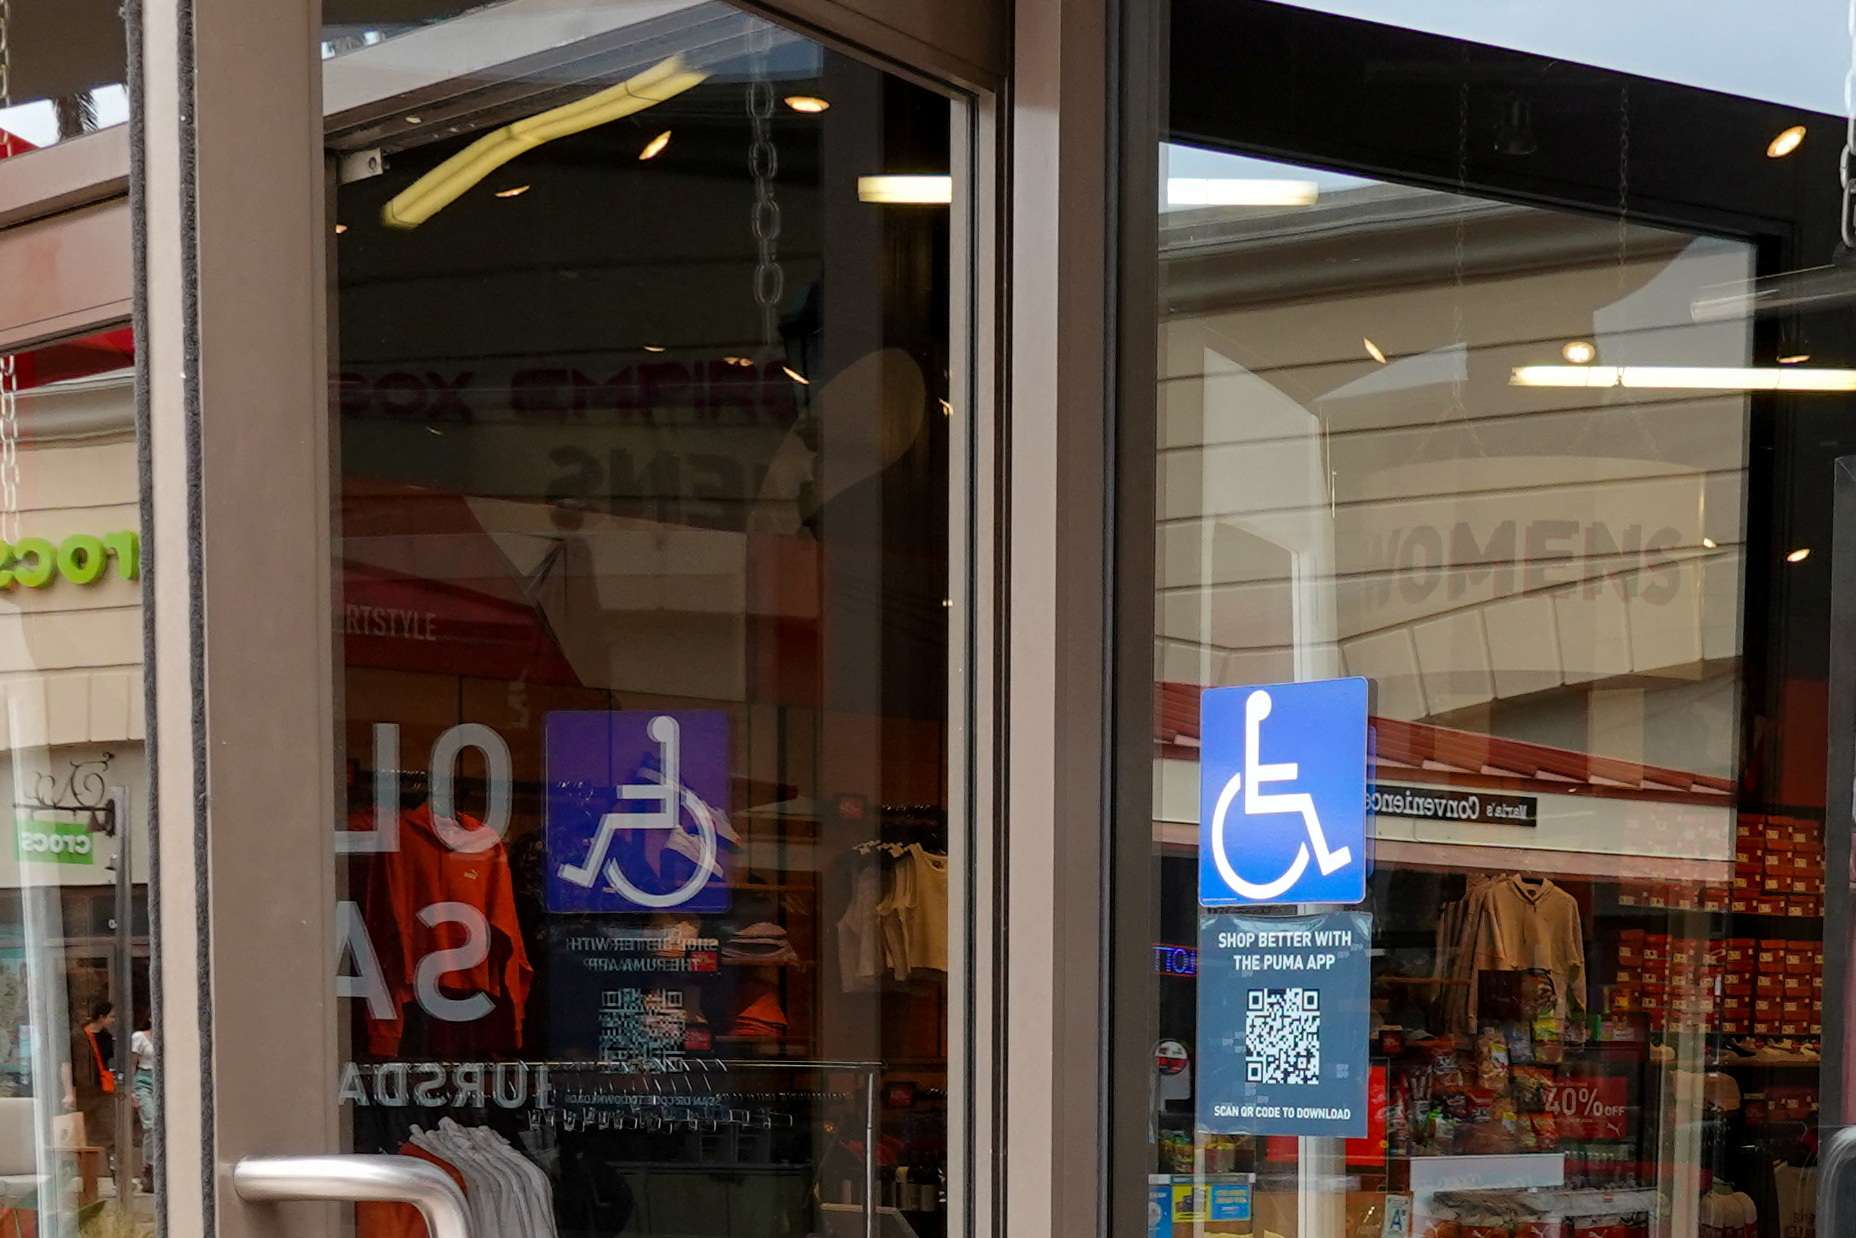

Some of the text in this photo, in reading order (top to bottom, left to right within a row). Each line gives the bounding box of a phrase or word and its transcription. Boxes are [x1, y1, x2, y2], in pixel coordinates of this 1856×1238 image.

[346, 604, 438, 640] RTSTYLE
[1218, 930, 1352, 949] SHOP BETTER WITH
[1233, 954, 1336, 971] THE PUMA APP
[1214, 1105, 1351, 1121] SCAN QR CODE TO DOWNLOAD
[1604, 1106, 1625, 1117] OFF
